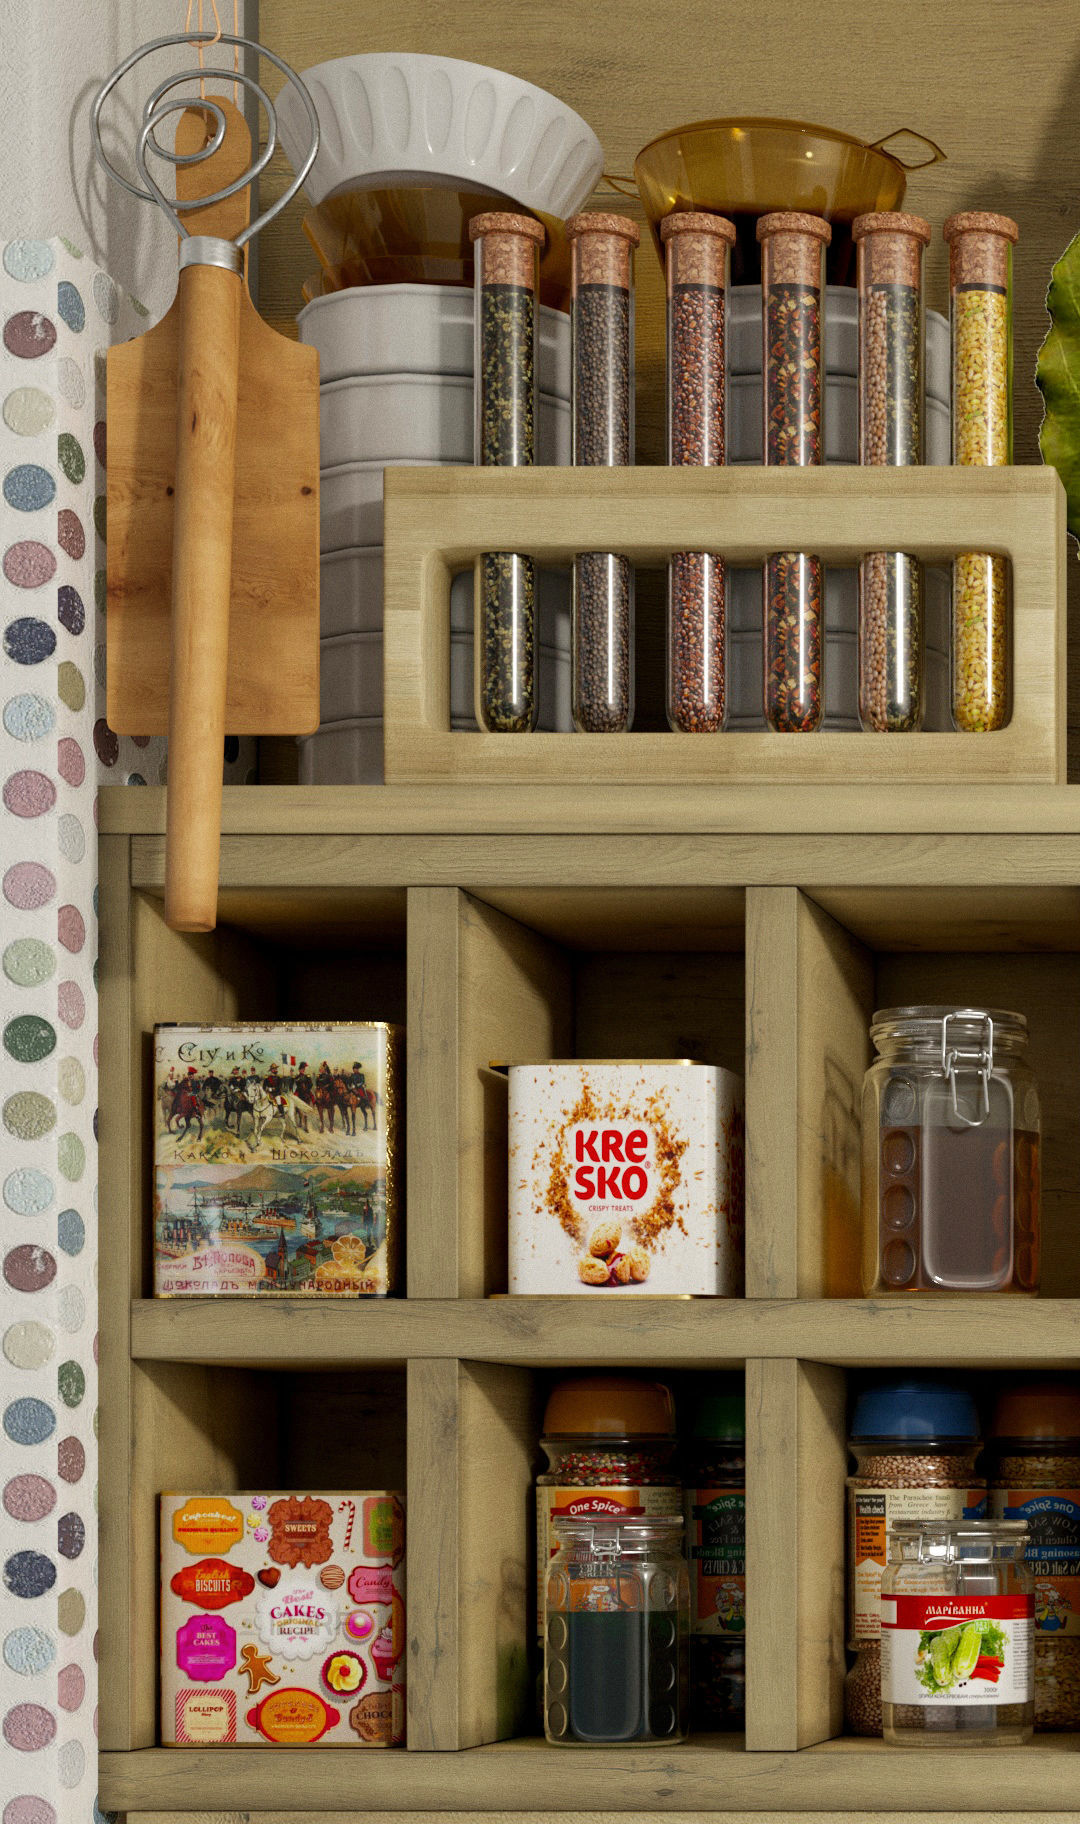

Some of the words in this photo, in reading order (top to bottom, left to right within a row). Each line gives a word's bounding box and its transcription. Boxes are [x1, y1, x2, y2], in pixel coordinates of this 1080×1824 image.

[569, 1502, 590, 1515] One
[908, 1501, 928, 1509] Greece
[285, 1523, 317, 1533] SWEETS
[195, 1569, 230, 1580] English
[195, 1579, 231, 1592] BISCUITS
[355, 1576, 391, 1588] Candy
[270, 1605, 326, 1620] CAKES
[200, 1624, 213, 1632] The
[275, 1618, 320, 1628] ORIGINAL
[196, 1632, 218, 1640] BEST
[279, 1627, 316, 1636] RECIPE
[193, 1639, 221, 1647] CAKES
[188, 1706, 224, 1714] LOLLIPOP
